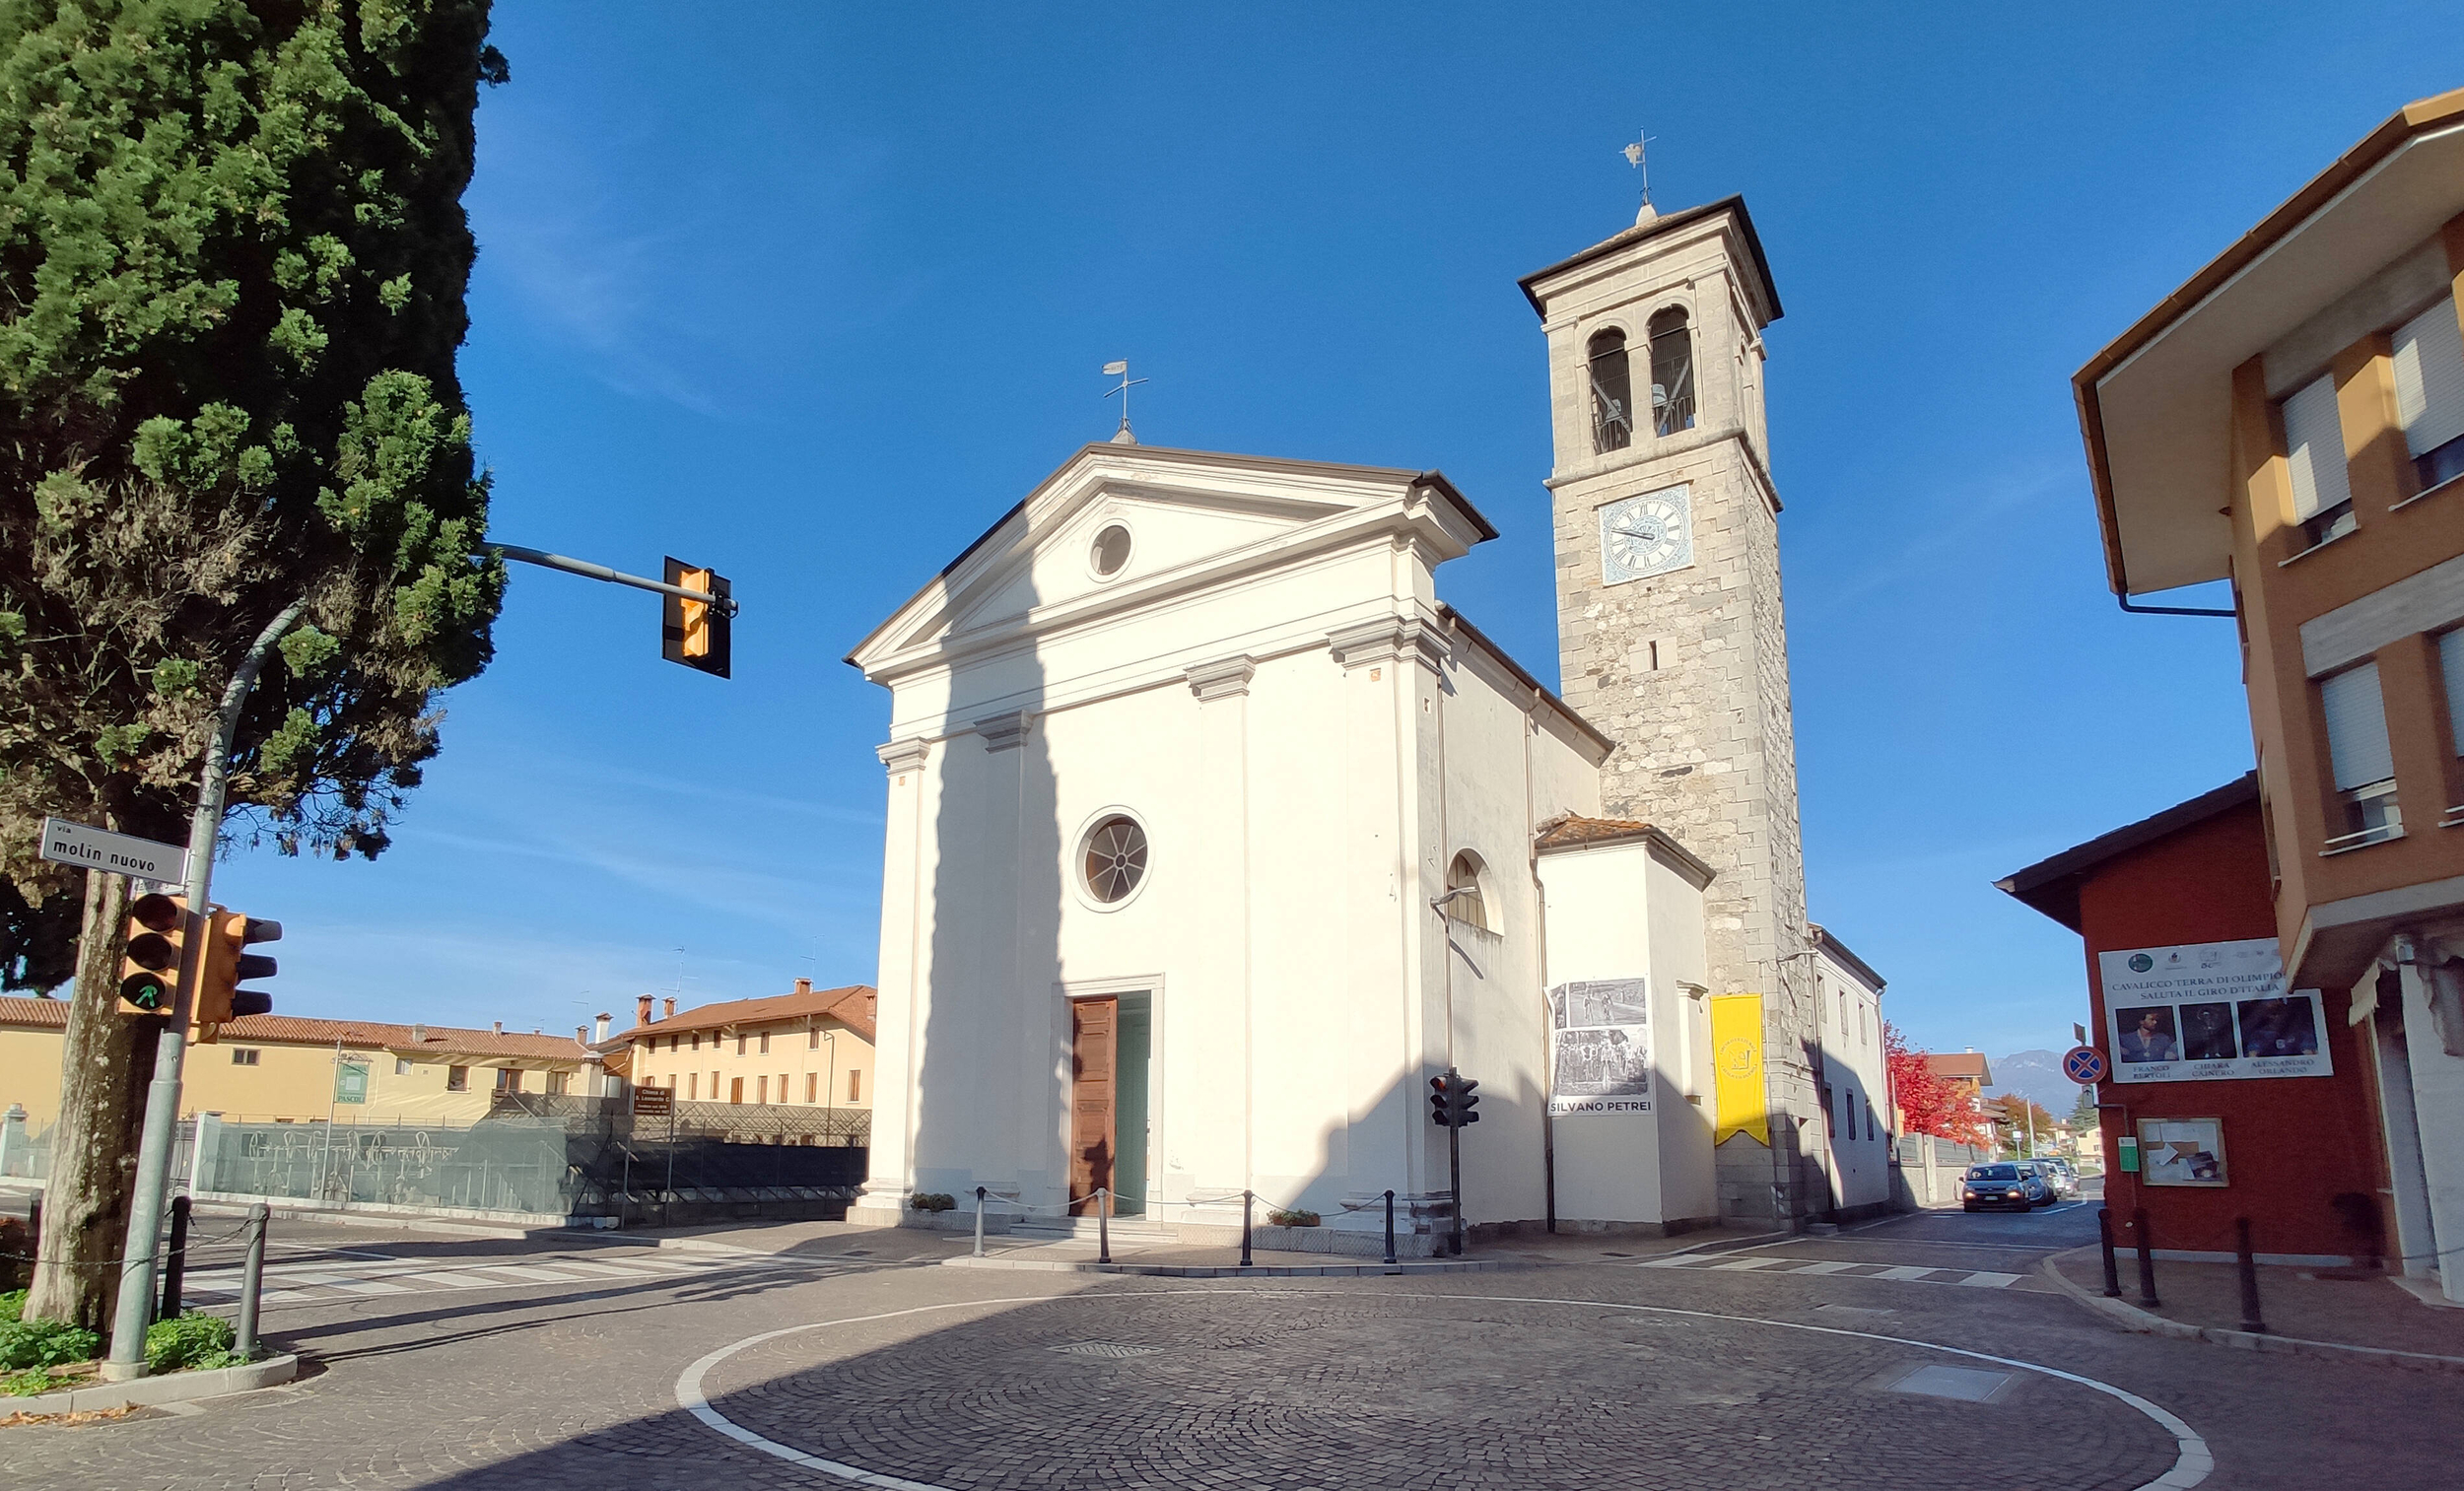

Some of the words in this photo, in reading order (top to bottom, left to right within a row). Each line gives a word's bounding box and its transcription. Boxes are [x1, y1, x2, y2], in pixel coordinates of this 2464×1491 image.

[56, 825, 72, 834] via
[52, 841, 103, 861] molin
[109, 852, 156, 872] nuovo
[2112, 980, 2172, 991] CAVALICCO
[2174, 977, 2214, 987] TERRA
[2216, 976, 2229, 984] DI
[2140, 989, 2182, 1000] SALUTA
[2184, 988, 2196, 997] IL
[2198, 986, 2227, 997] GIRO
[2229, 983, 2280, 995] D'ITALIA
[2251, 1058, 2315, 1068] ALESSANDRO
[2259, 1066, 2308, 1075] ORLANDO
[1550, 1102, 1604, 1112] SILVANO
[1608, 1101, 1651, 1112] PETREI
